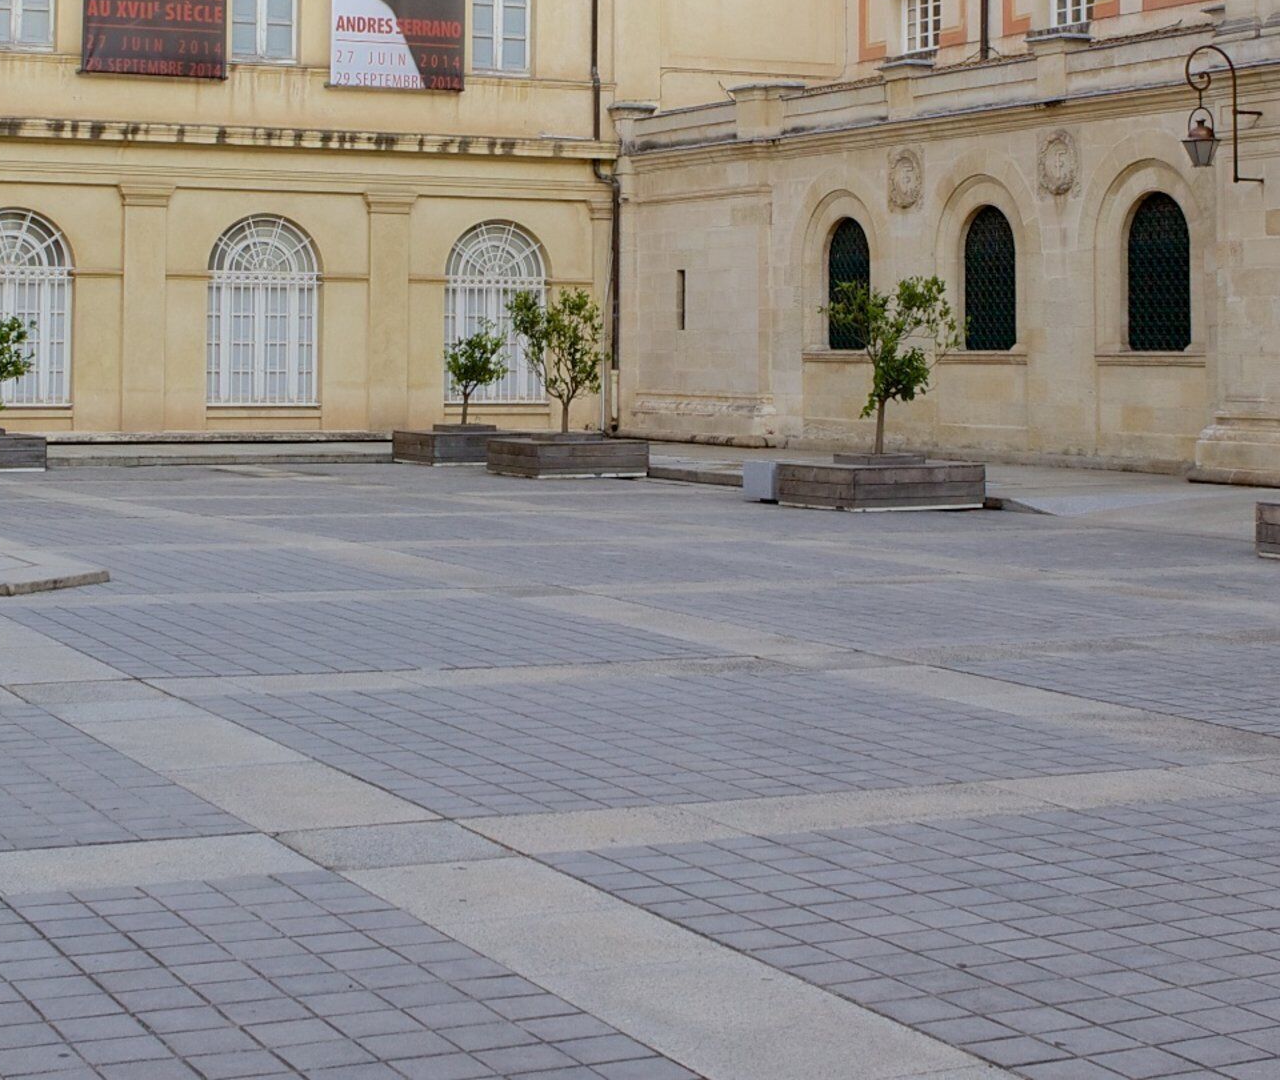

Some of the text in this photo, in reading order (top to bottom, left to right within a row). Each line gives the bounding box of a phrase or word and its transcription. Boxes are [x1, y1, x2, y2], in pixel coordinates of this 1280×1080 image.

[87, 0, 111, 17] AU
[165, 0, 223, 23] SIÈCLE
[336, 15, 462, 38] ANDRES SERRANO
[86, 34, 221, 54] 27 JUIN 2014
[86, 57, 221, 77] 29 SEPTEMBRE 2014
[336, 50, 461, 69] 27 JUIN 2014
[336, 71, 461, 89] 29 SEPTEMBRE 2014
